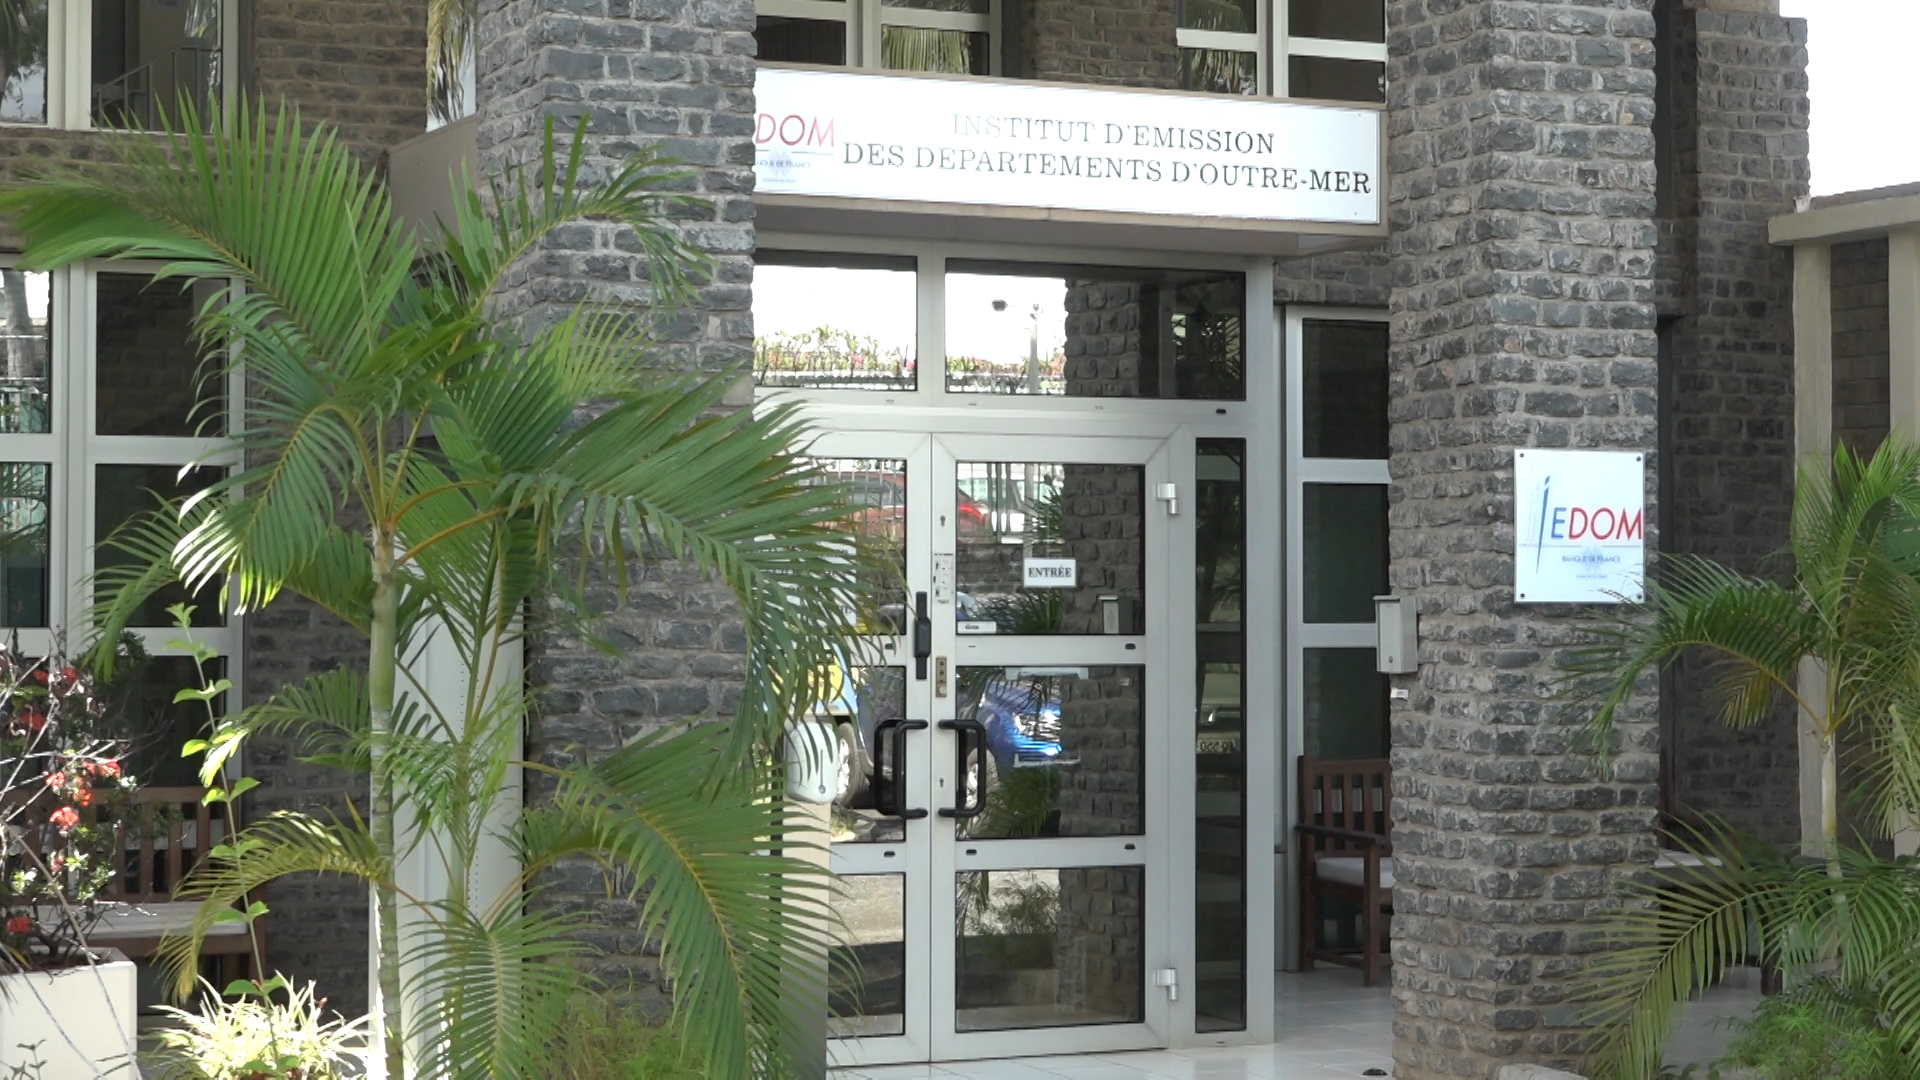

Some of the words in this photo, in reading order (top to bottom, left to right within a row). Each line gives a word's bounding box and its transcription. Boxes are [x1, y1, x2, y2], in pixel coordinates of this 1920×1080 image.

[755, 113, 835, 148] DOM
[952, 113, 1096, 143] INSTITUT
[1104, 122, 1275, 155] D'EMISSION
[842, 141, 905, 167] DES
[915, 145, 1162, 182] DEPARTEMENTS
[1171, 160, 1372, 194] D'OUTRE-MER
[1028, 564, 1072, 578] ENTRÉE
